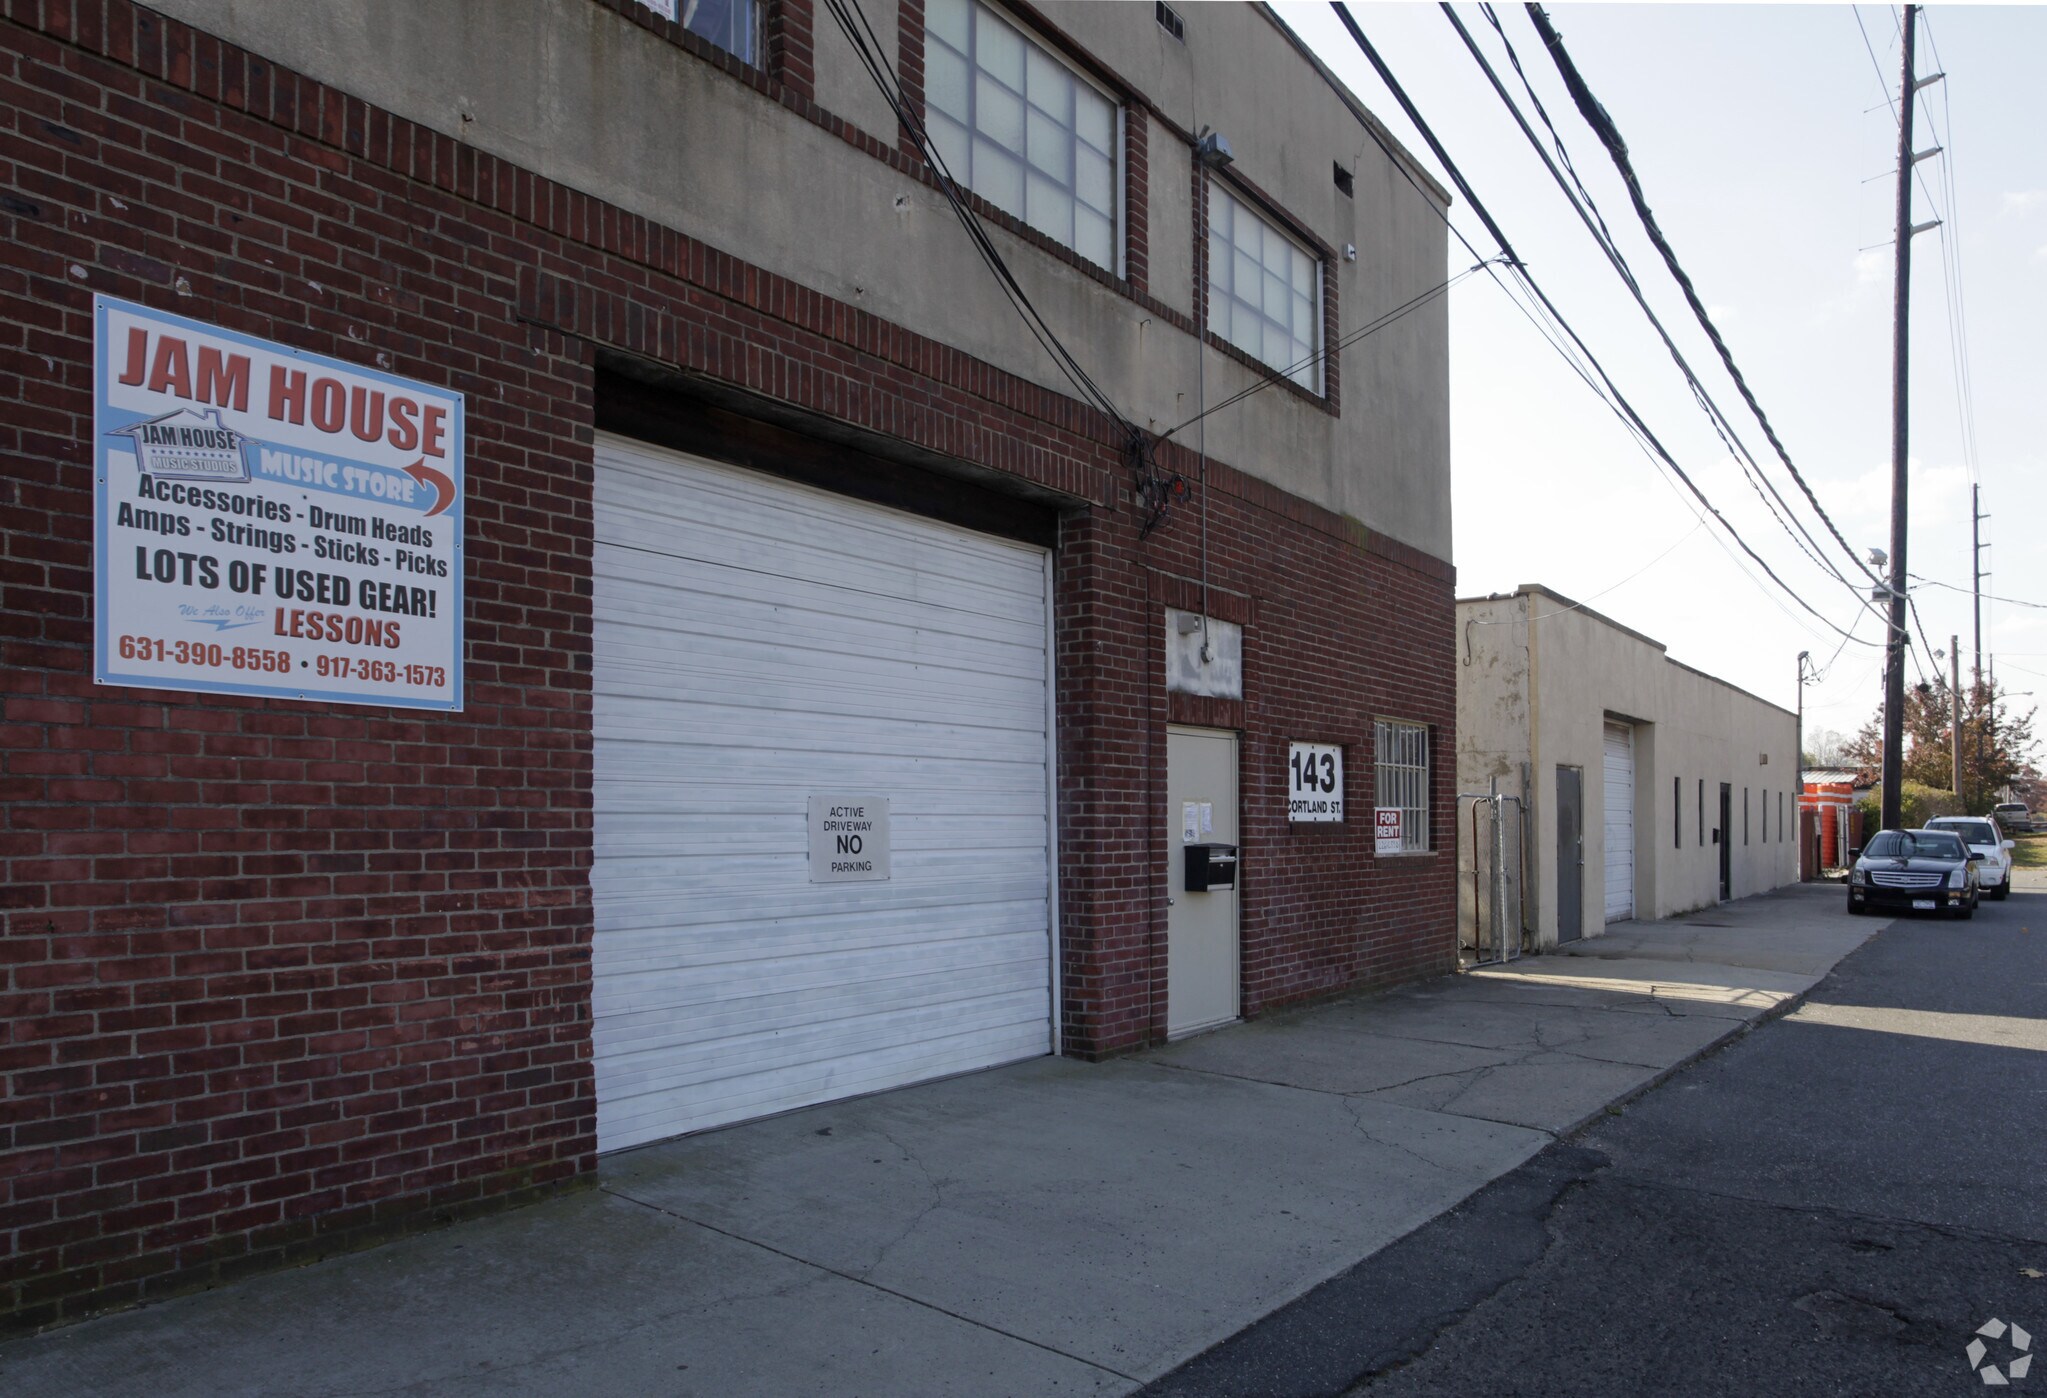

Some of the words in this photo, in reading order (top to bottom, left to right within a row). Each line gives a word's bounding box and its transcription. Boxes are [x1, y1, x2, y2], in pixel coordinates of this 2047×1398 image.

[118, 326, 250, 413] JAM
[268, 364, 447, 458] HOUSE
[142, 425, 177, 446] JAM
[180, 427, 236, 450] HOUSE
[152, 457, 189, 470] MUSIC
[191, 460, 237, 472] STUDIOS
[261, 449, 338, 488] MUSIC
[343, 466, 415, 503] STORE
[138, 473, 291, 523] Accessories
[310, 505, 367, 537] Drum
[372, 516, 433, 548] Heads
[117, 501, 191, 537] Amps
[211, 517, 296, 554] Strings
[314, 535, 380, 567] Sticks
[396, 549, 448, 578] Picks
[136, 546, 219, 589] LOTS
[228, 560, 267, 595] OF
[275, 566, 350, 607] USED
[359, 579, 437, 619] GEAR!
[178, 603, 201, 616] We
[203, 604, 231, 617] Also
[235, 605, 265, 621] Offer
[274, 607, 401, 649] LESSONS
[119, 635, 291, 674] 631-390-8558
[316, 655, 446, 688] 917-363-1573
[1291, 751, 1336, 794] 143
[829, 806, 865, 818] ACTIVE
[1380, 812, 1397, 825] FOR
[823, 820, 873, 832] DRIVEWAY
[1377, 825, 1400, 838] RENT
[836, 834, 863, 855] NO
[831, 861, 873, 873] PARKING
